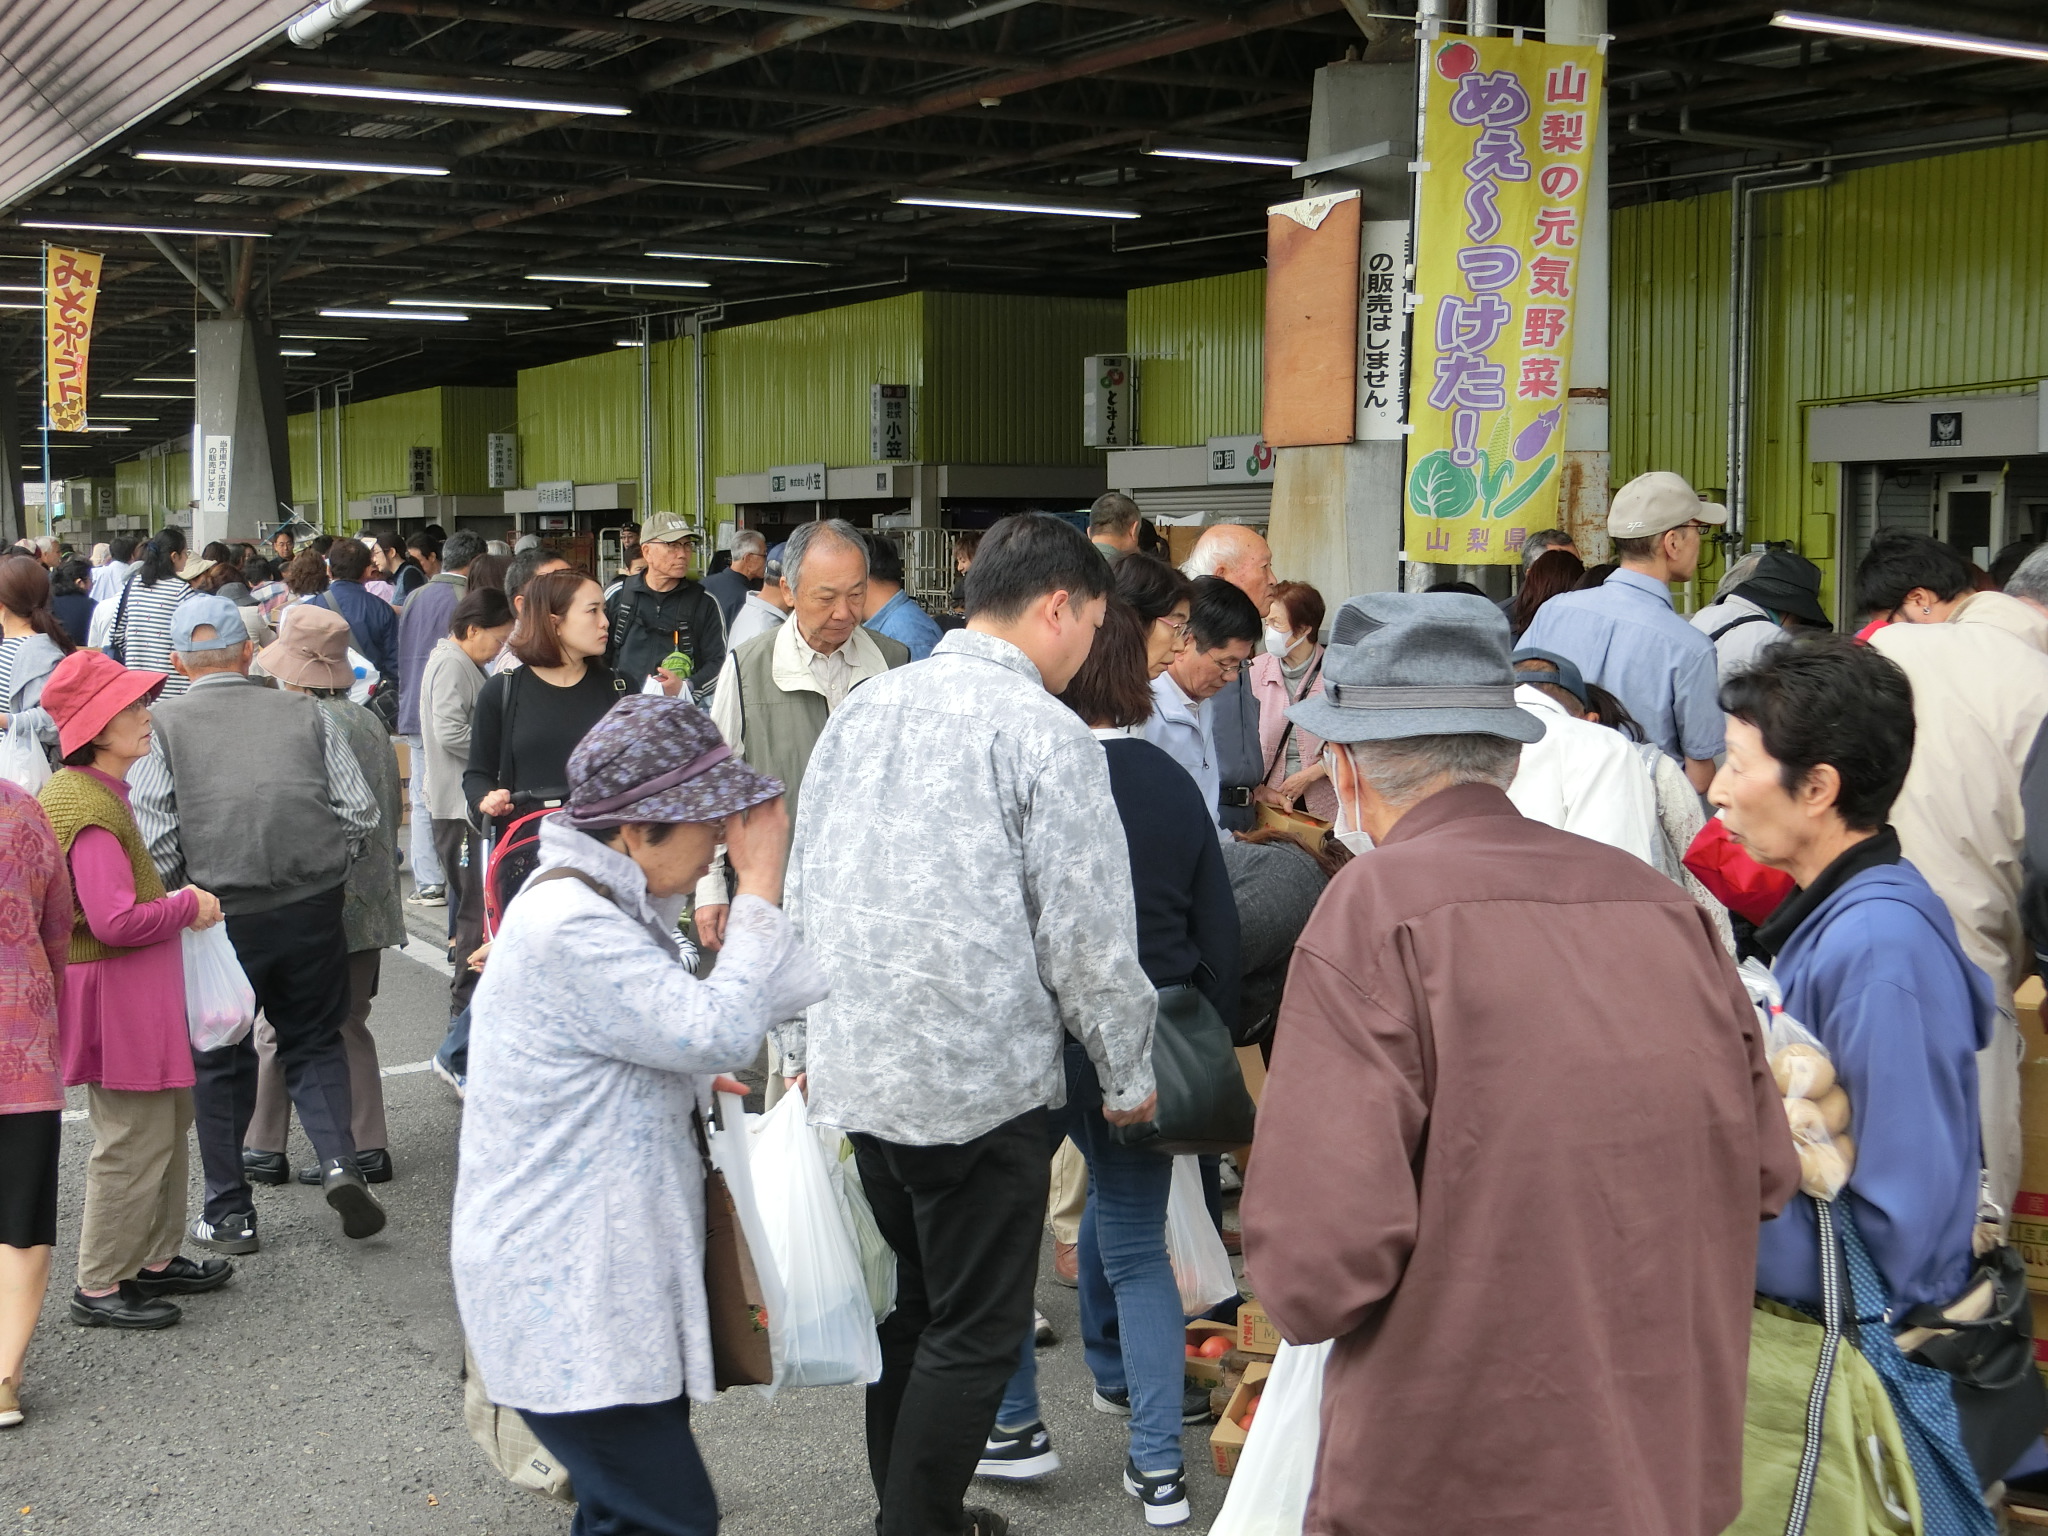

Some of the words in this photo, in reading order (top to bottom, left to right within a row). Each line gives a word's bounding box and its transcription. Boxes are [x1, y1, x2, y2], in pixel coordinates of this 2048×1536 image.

[1516, 63, 1589, 399] 山梨の元気野菜
[53, 253, 95, 403] みそポテト
[886, 421, 902, 458] 小笠
[1213, 450, 1235, 470] 仲卸
[806, 472, 821, 490] 小笠
[1426, 527, 1527, 553] 山梨県
[1264, 1326, 1276, 1340] M
[1157, 1483, 1173, 1494] NIKE
